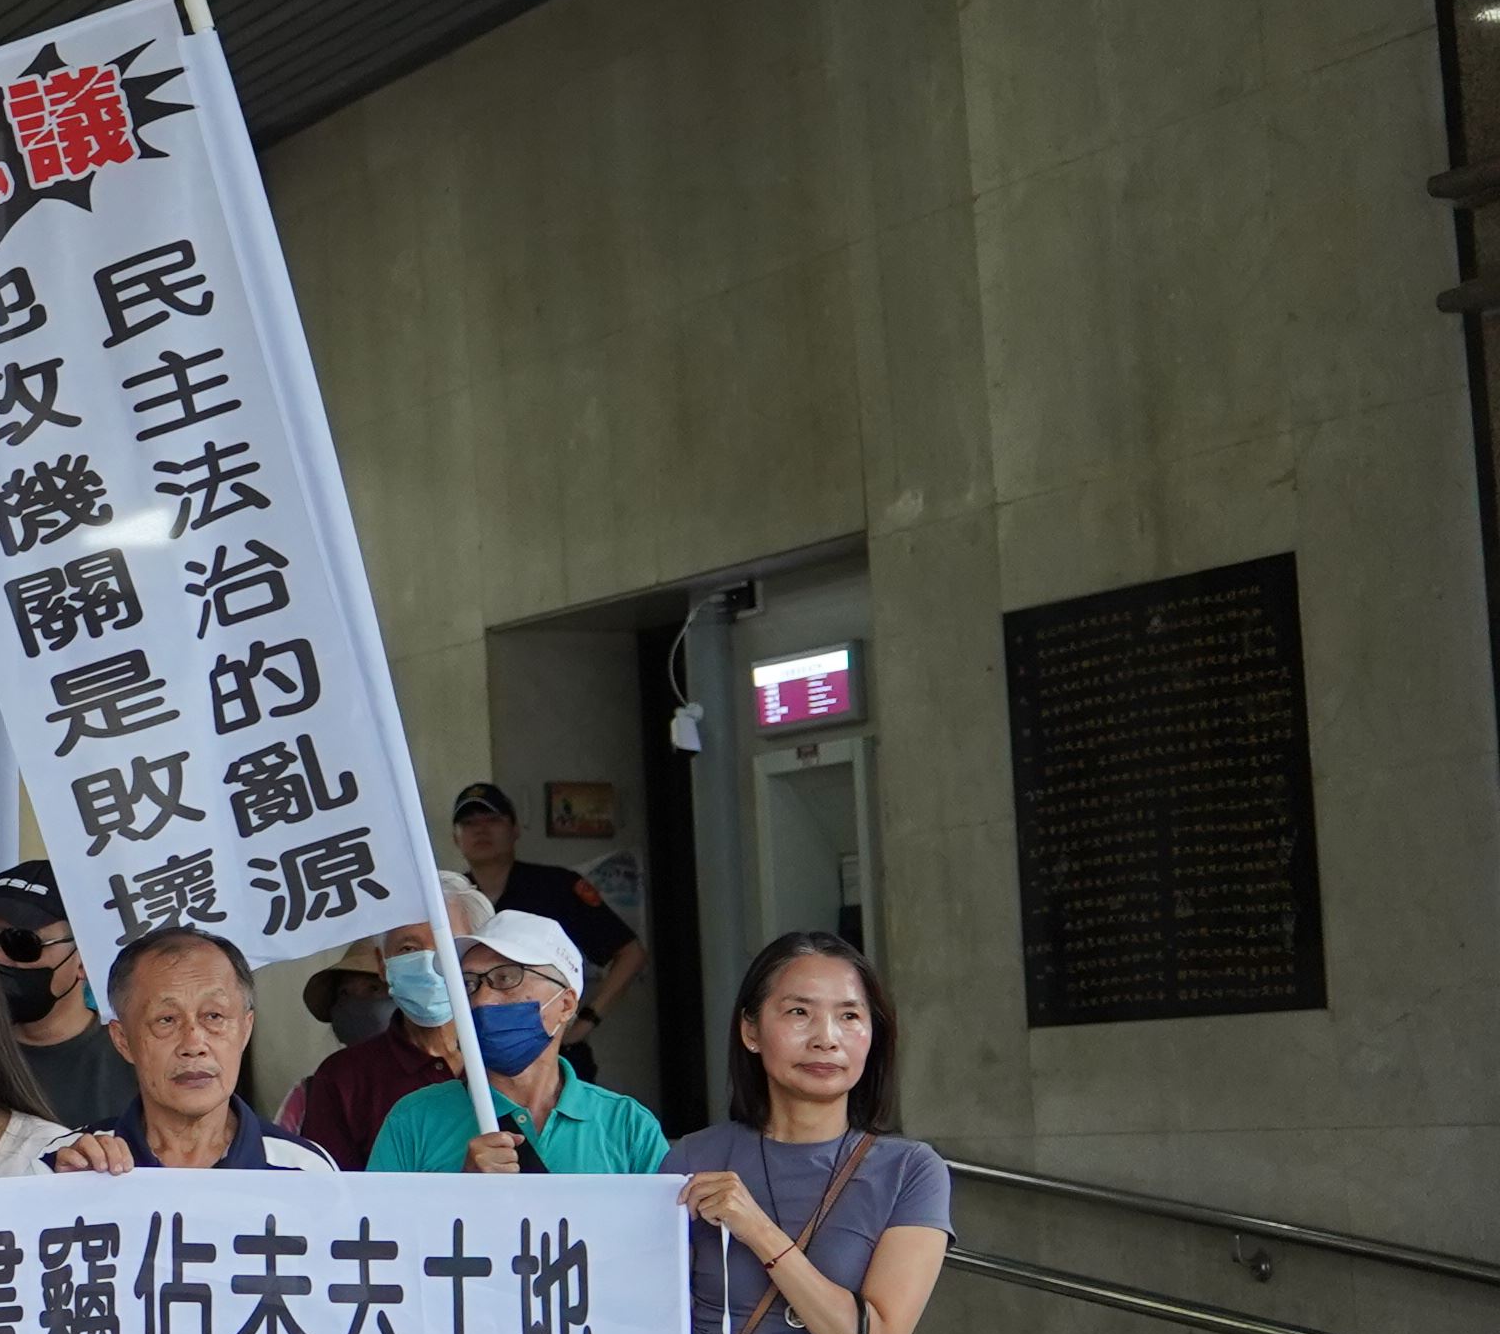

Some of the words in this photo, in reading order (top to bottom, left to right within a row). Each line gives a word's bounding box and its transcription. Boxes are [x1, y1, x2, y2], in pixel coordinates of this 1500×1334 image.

[93, 238, 391, 937] 民主法治的亂源
